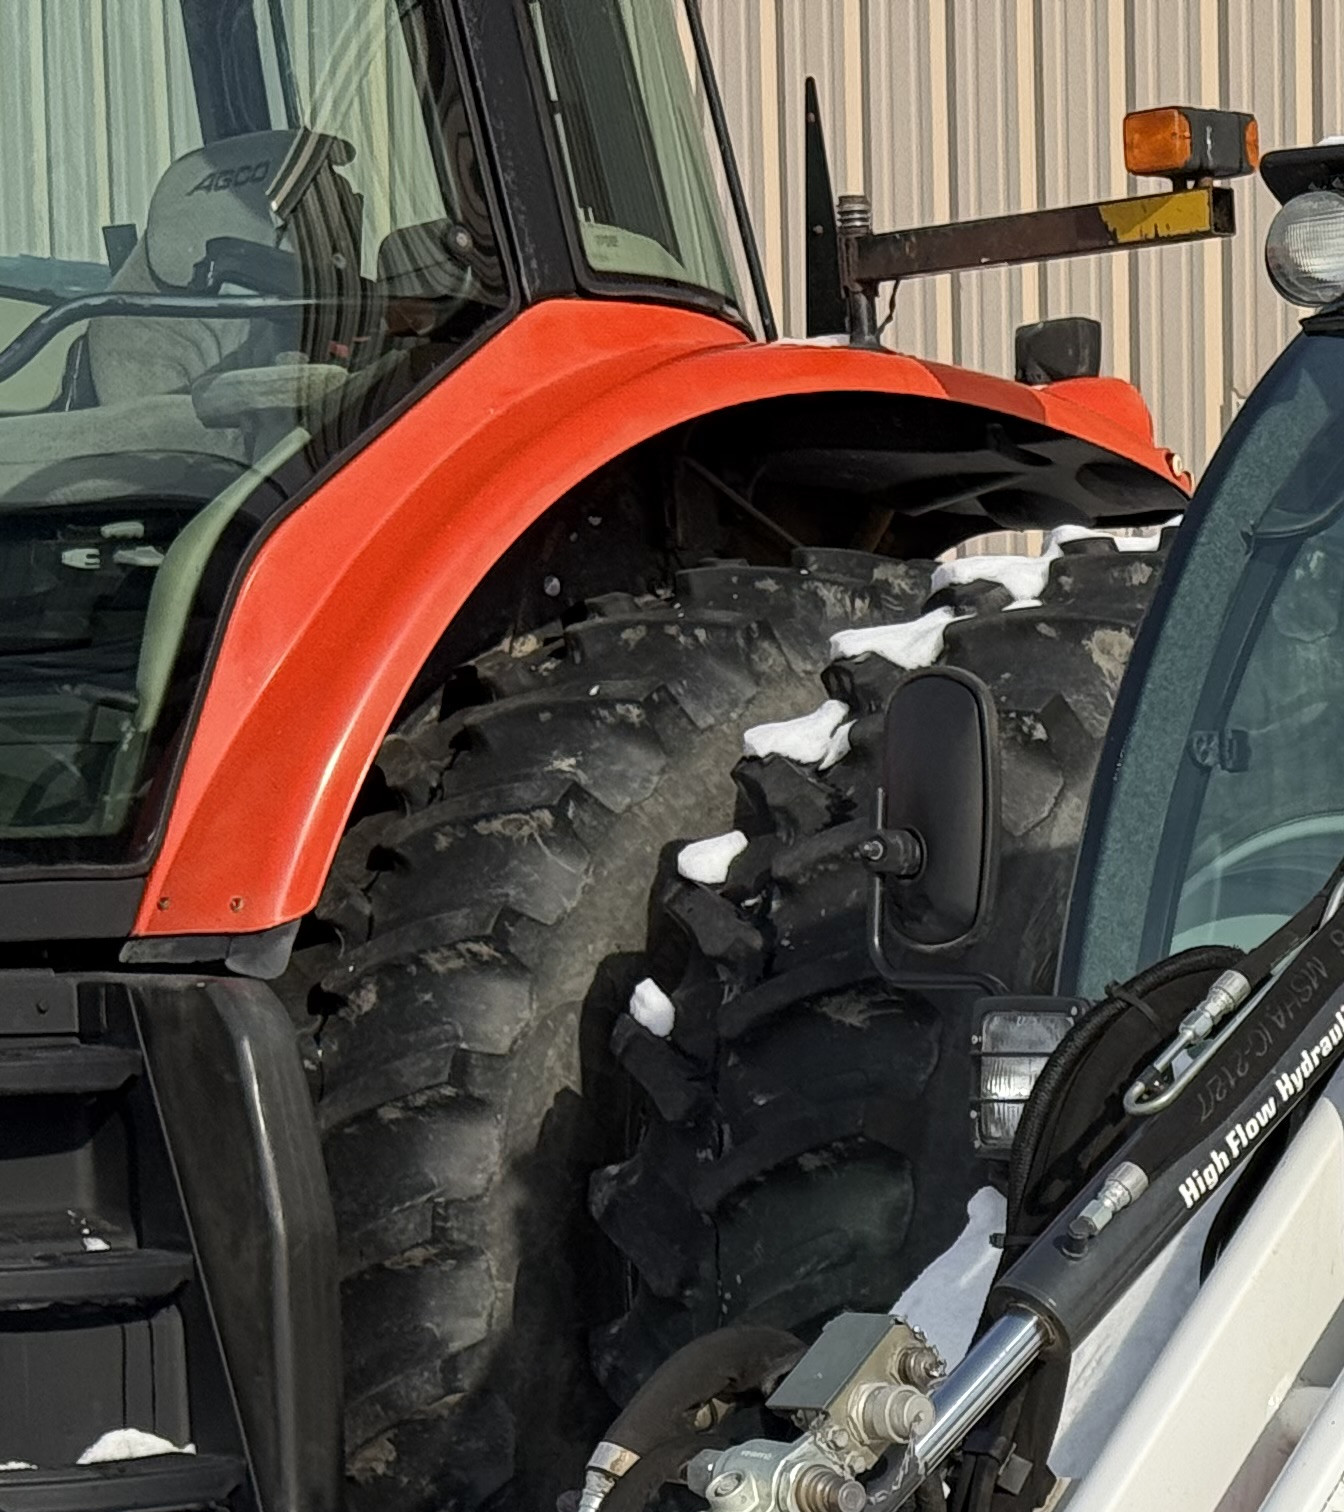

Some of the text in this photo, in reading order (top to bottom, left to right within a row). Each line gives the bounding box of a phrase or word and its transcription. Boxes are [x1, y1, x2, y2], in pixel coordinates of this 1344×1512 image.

[186, 160, 271, 196] AGCO
[1268, 956, 1329, 1030] MSHA
[1178, 1150, 1231, 1209] High
[1224, 1097, 1278, 1159] Flow
